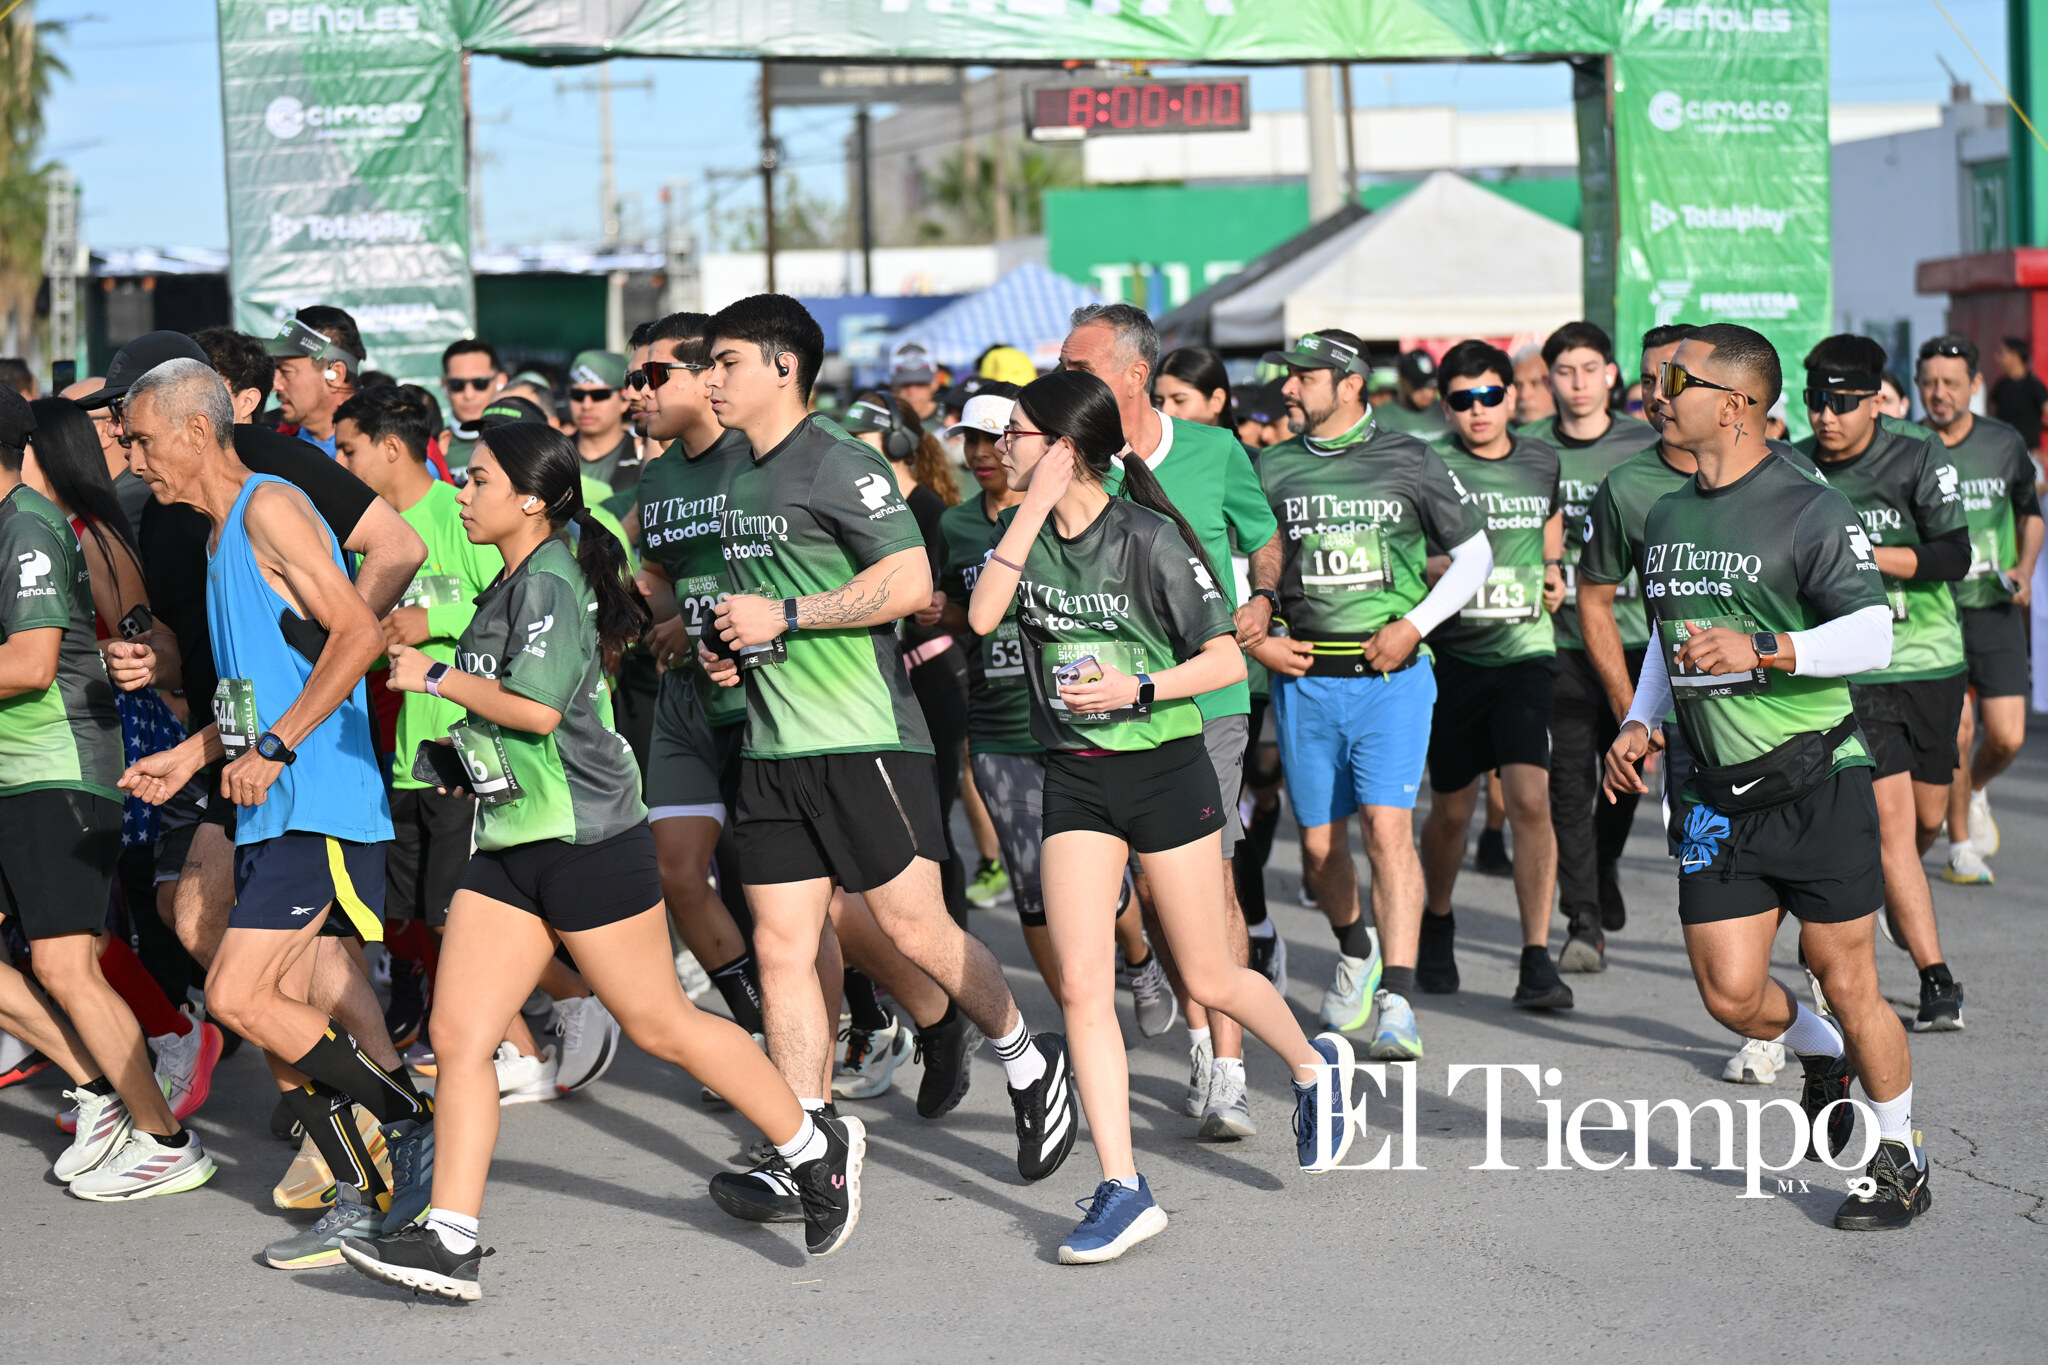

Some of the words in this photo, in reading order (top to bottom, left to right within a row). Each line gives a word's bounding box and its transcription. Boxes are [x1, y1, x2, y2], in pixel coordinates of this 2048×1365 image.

[306, 102, 425, 126] cimaco
[1686, 100, 1790, 121] cimaco
[303, 212, 423, 243] Totalplay
[1679, 203, 1787, 234] Totalplay
[643, 501, 660, 529] El
[662, 493, 727, 524] Tiemp
[1284, 496, 1309, 523] El
[1311, 494, 1403, 523] Tiempo
[663, 519, 721, 543] todos
[729, 509, 789, 542] Tiempo
[1487, 514, 1543, 531] todos
[722, 544, 732, 561] e
[732, 540, 774, 560] todos
[1313, 547, 1370, 576] 104
[1645, 543, 1668, 575] El
[1670, 542, 1762, 580] Tiempo
[16, 587, 57, 599] PEÑOLES
[1018, 580, 1038, 608] El
[1037, 584, 1130, 619] Tiempo
[1476, 583, 1526, 610] 143
[1646, 579, 1666, 599] de
[1668, 576, 1733, 597] todos
[1045, 613, 1119, 631] todos
[1674, 619, 1713, 629] CAERA
[1743, 620, 1755, 628] 119
[1133, 647, 1145, 655] 117
[213, 699, 237, 733] 544
[244, 697, 258, 749] MEDALLA
[494, 736, 518, 790] MEDALLA
